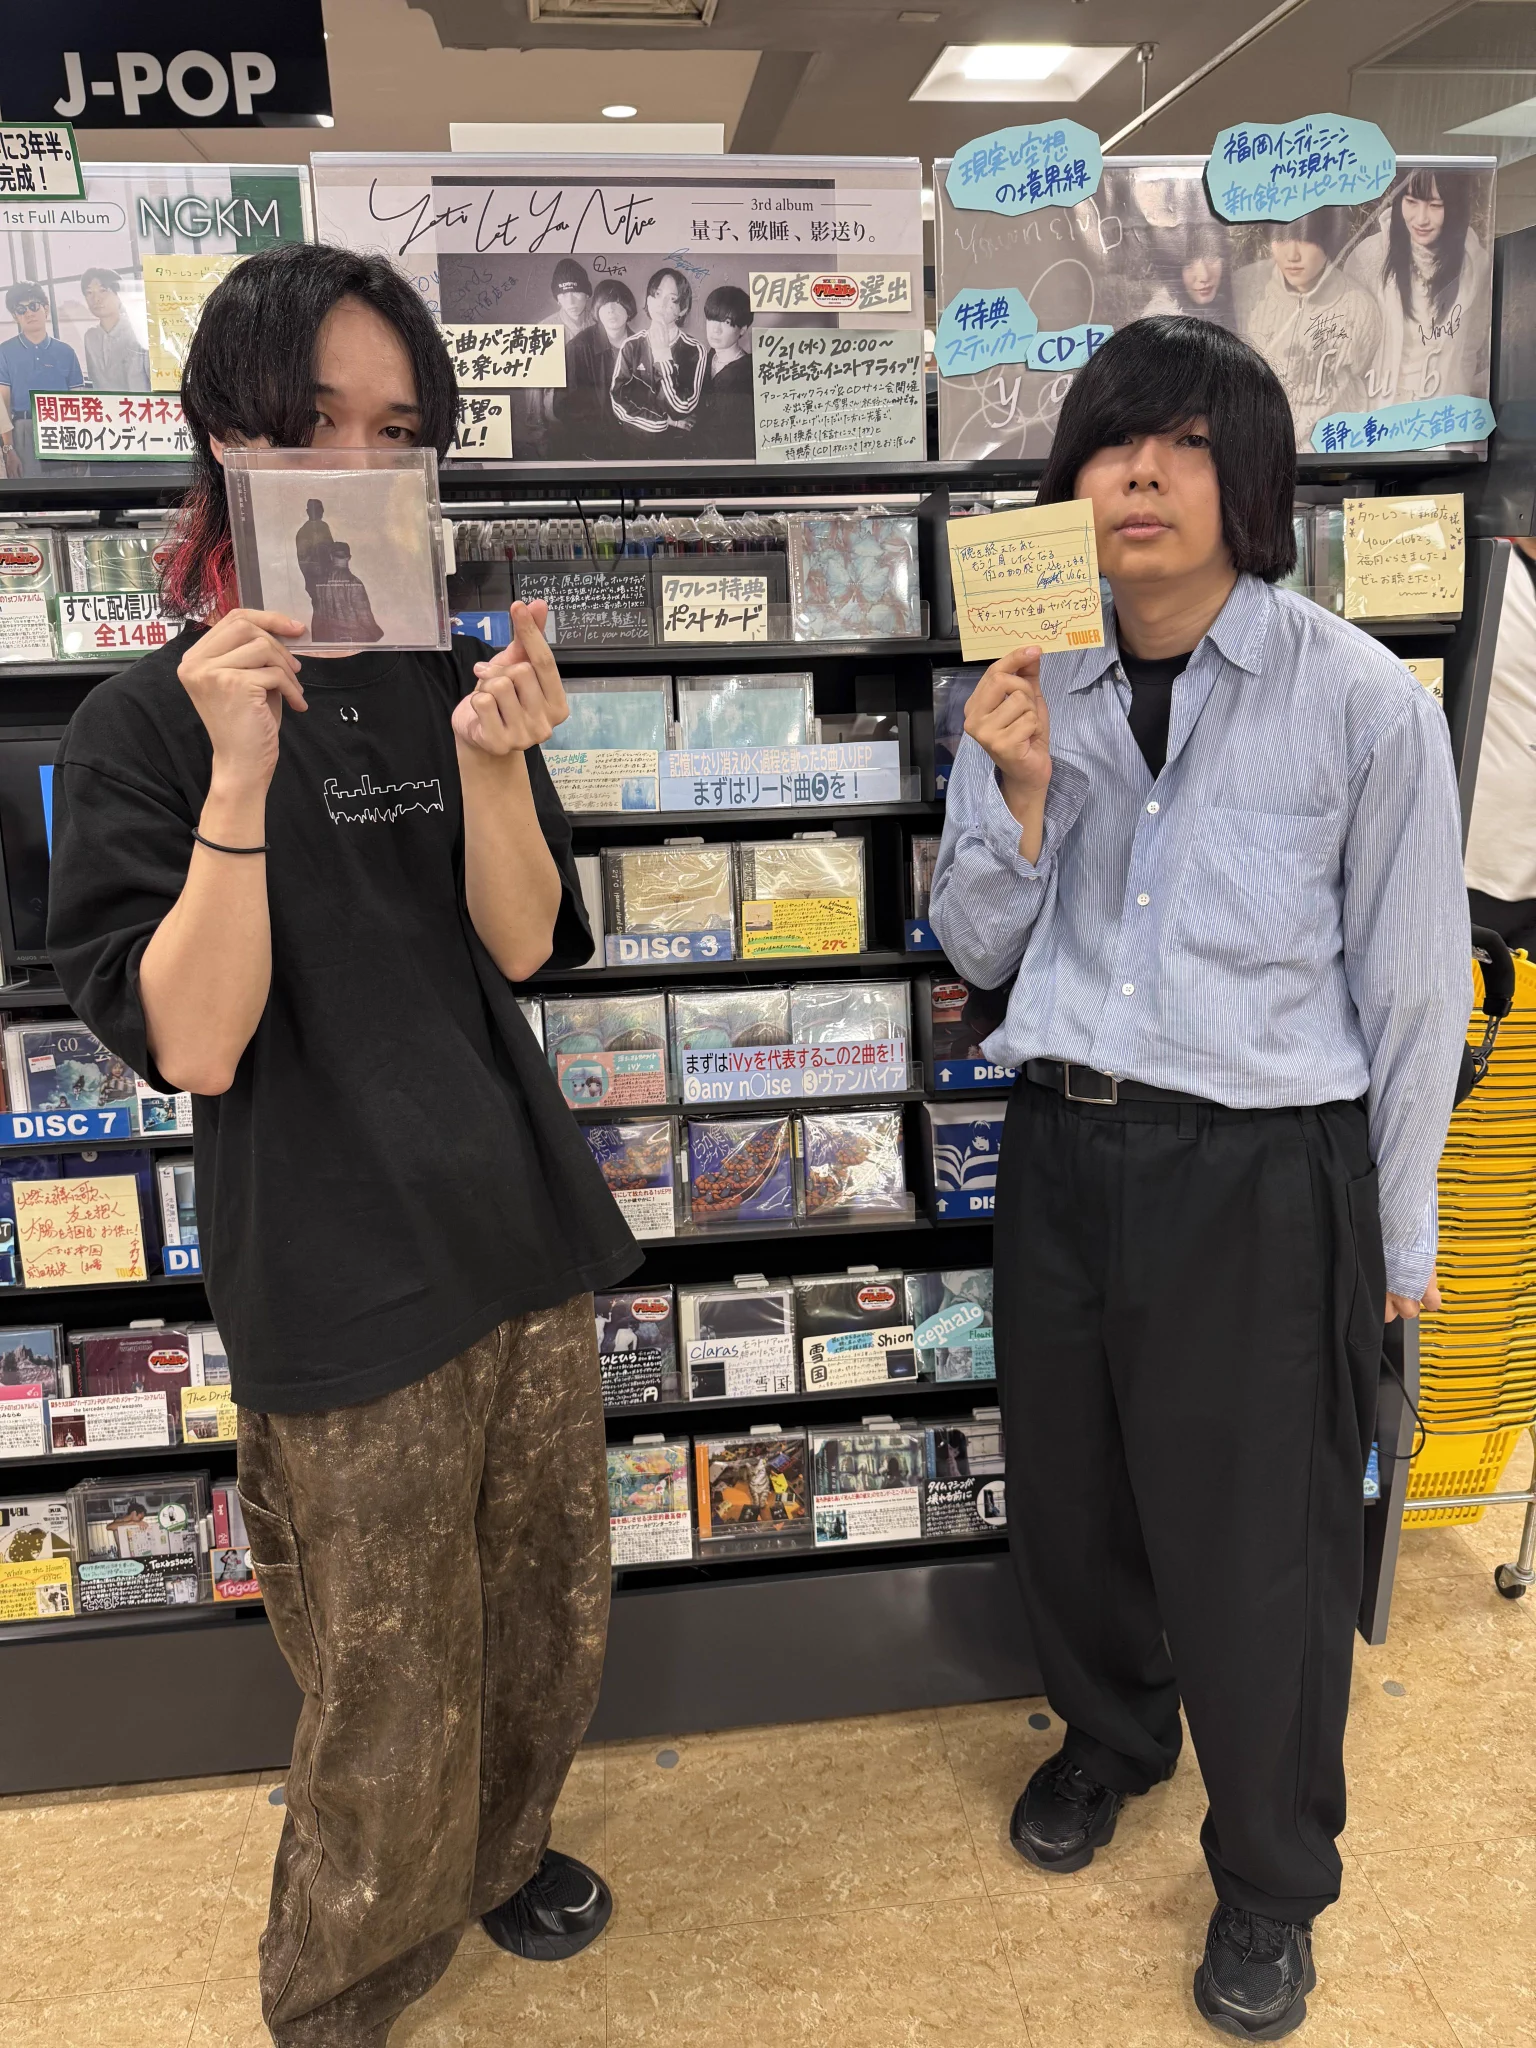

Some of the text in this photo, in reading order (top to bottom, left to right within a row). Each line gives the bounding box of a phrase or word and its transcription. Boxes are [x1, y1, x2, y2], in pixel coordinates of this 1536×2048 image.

[53, 50, 276, 116] J-POP
[958, 131, 1068, 185] 現実と空想
[1270, 149, 1357, 181] から現れた
[996, 160, 1091, 203] の境界線
[4, 211, 110, 224] 1st Full Album
[139, 198, 281, 237] NGKM
[751, 198, 813, 211] 3rd album
[690, 220, 876, 243] 量子、微睡、影送り。
[859, 274, 907, 310] 選出
[955, 297, 1009, 331] 特典
[945, 328, 1034, 365] ステッカー
[1322, 405, 1487, 453] 静と動が交錯する
[664, 578, 766, 601] タワレコ特典
[665, 604, 762, 631] ポストカード
[1066, 629, 1101, 646] TOWER
[619, 935, 719, 960] DISC 3
[13, 1112, 117, 1139] DISC 7
[918, 1303, 982, 1347] cephalo
[878, 1332, 913, 1348] Shion
[600, 1352, 637, 1366] ひとひら
[187, 1391, 206, 1405] The
[149, 1557, 194, 1570] Texas3000
